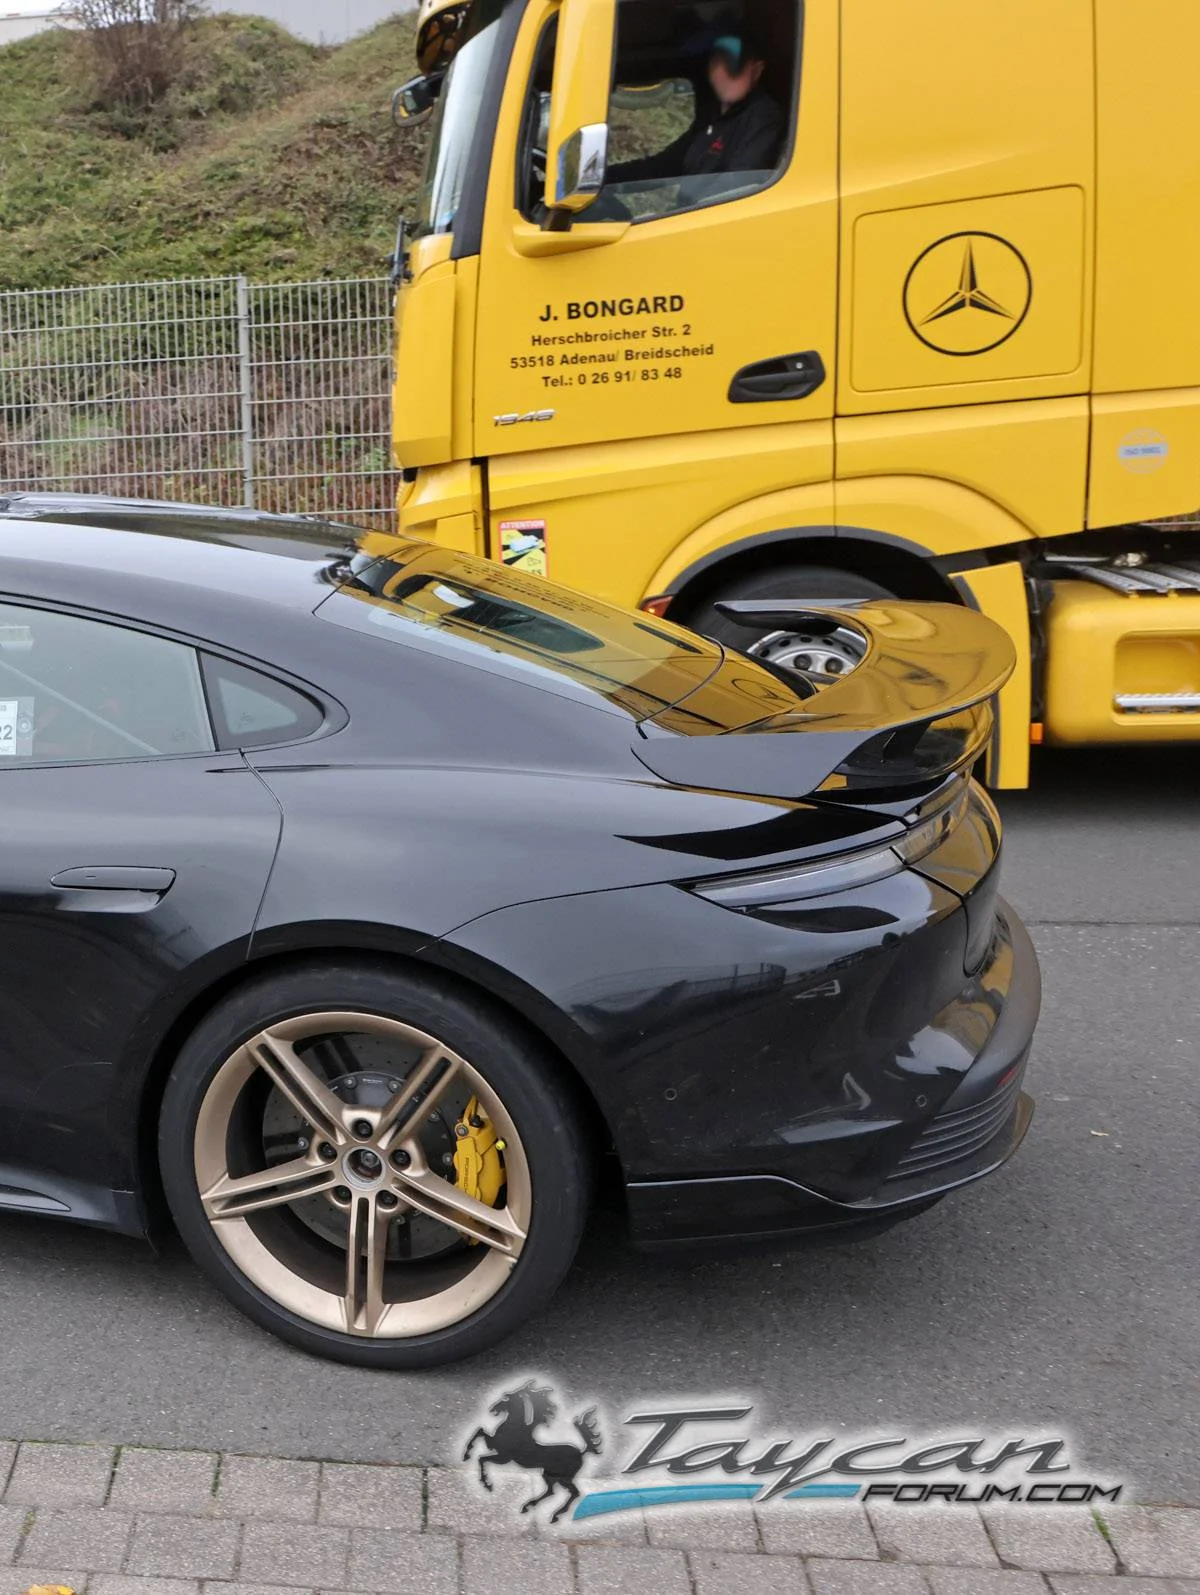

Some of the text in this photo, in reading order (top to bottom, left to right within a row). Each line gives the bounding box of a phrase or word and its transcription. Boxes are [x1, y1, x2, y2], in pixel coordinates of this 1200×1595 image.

[539, 295, 684, 322] J. BONGARD
[531, 324, 691, 347] Herschbroicher Str. 2
[510, 355, 555, 369] 53518
[625, 344, 714, 361] Breidscheid
[542, 375, 573, 388] Tel.:
[578, 373, 586, 386] 0
[592, 371, 609, 384] 26
[641, 368, 659, 381] 83
[664, 367, 682, 379] 48
